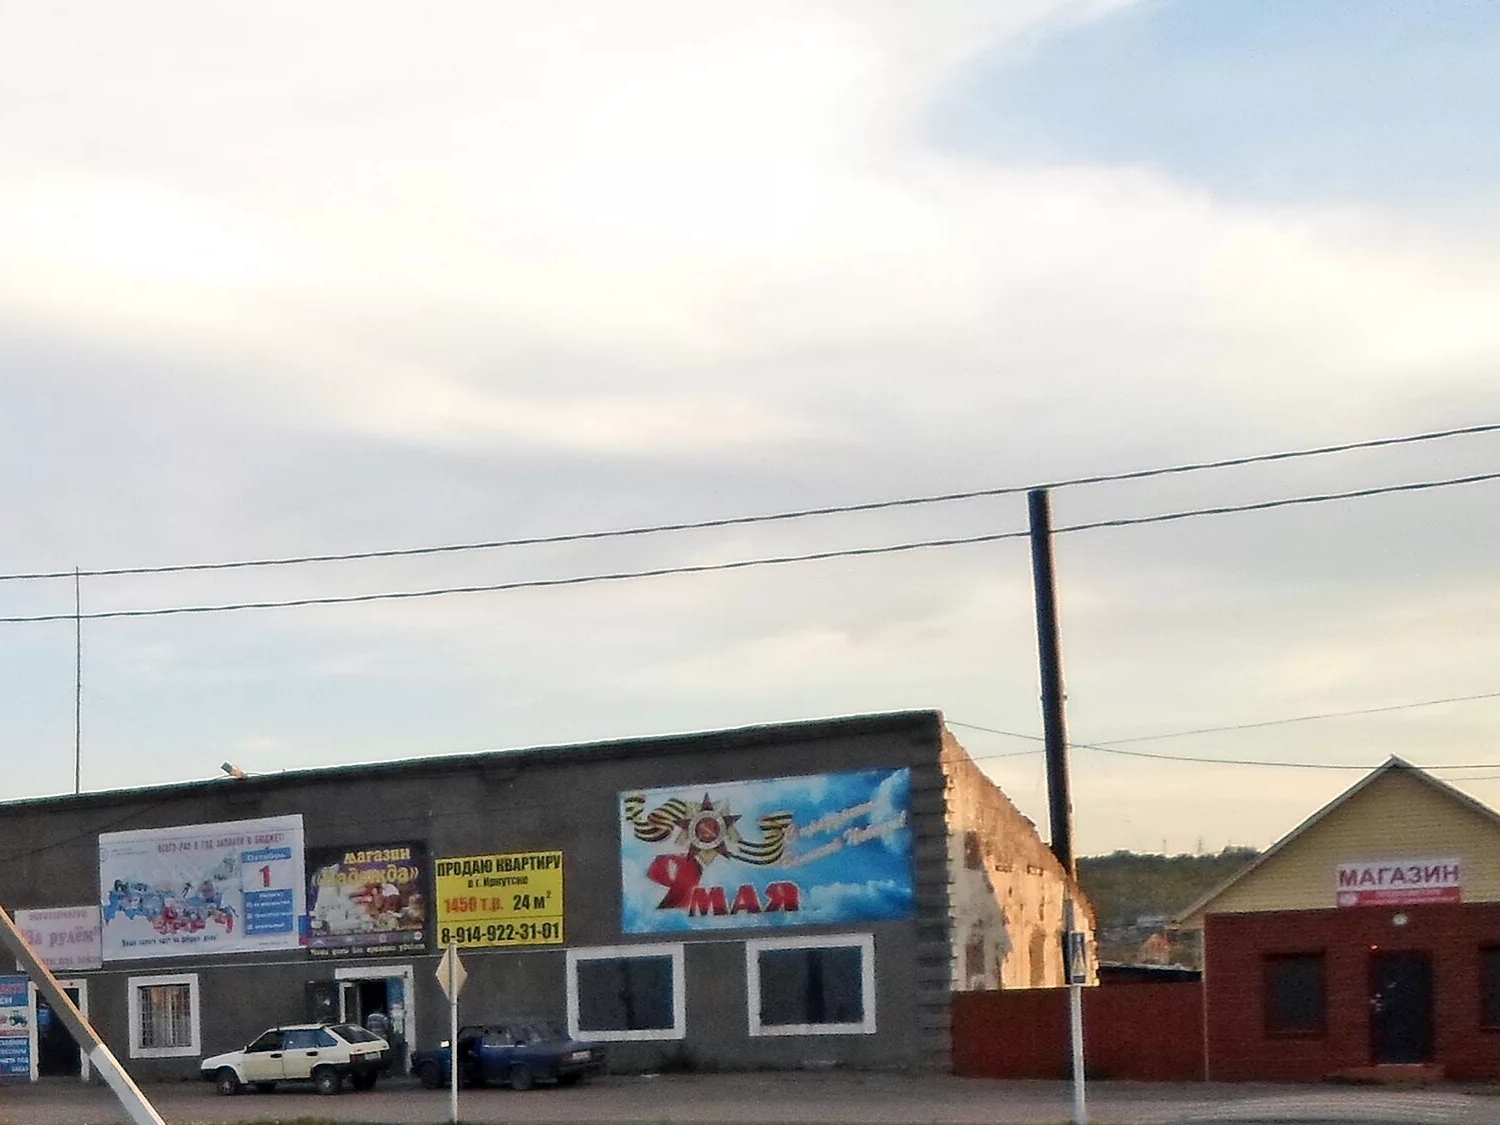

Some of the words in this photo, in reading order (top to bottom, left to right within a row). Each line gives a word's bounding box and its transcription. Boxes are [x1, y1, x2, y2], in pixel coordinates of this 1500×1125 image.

[259, 865, 271, 888] 1
[437, 859, 493, 877] ПРОДАЮ
[495, 854, 562, 873] КВАРТИРУ
[1338, 864, 1459, 887] МАГАЗИН
[646, 853, 703, 910] 9
[444, 896, 477, 914] 1450
[513, 894, 531, 911] 24
[441, 922, 560, 944] 8-914-922-31-01
